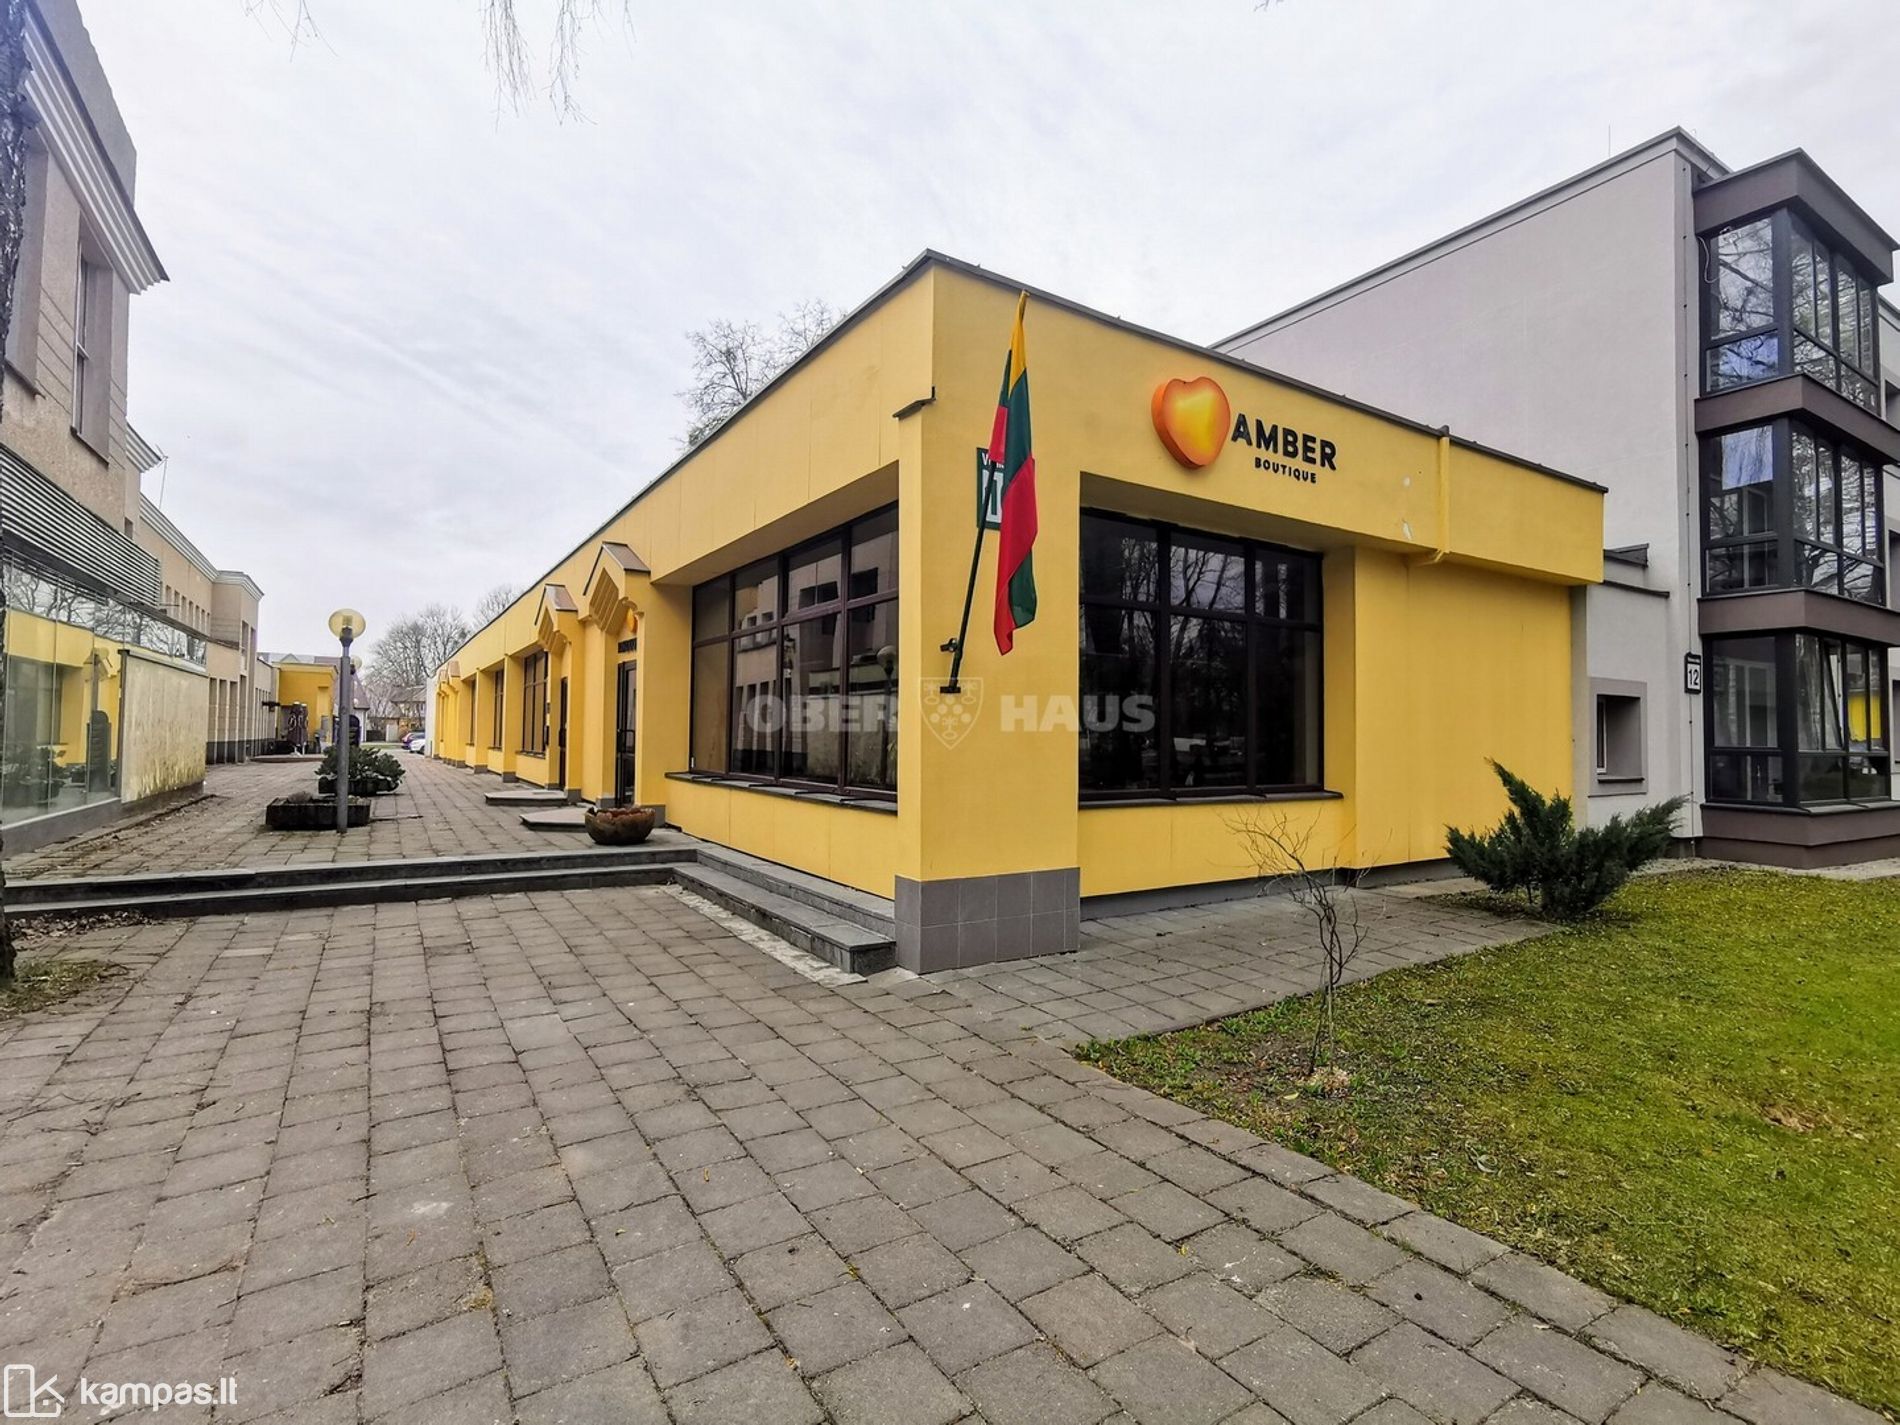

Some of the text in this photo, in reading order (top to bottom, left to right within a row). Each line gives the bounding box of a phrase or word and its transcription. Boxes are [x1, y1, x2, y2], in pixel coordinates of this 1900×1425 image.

[1231, 413, 1337, 471] AMBER
[1254, 456, 1317, 484] BOUTIQUE
[1689, 669, 1699, 686] 12
